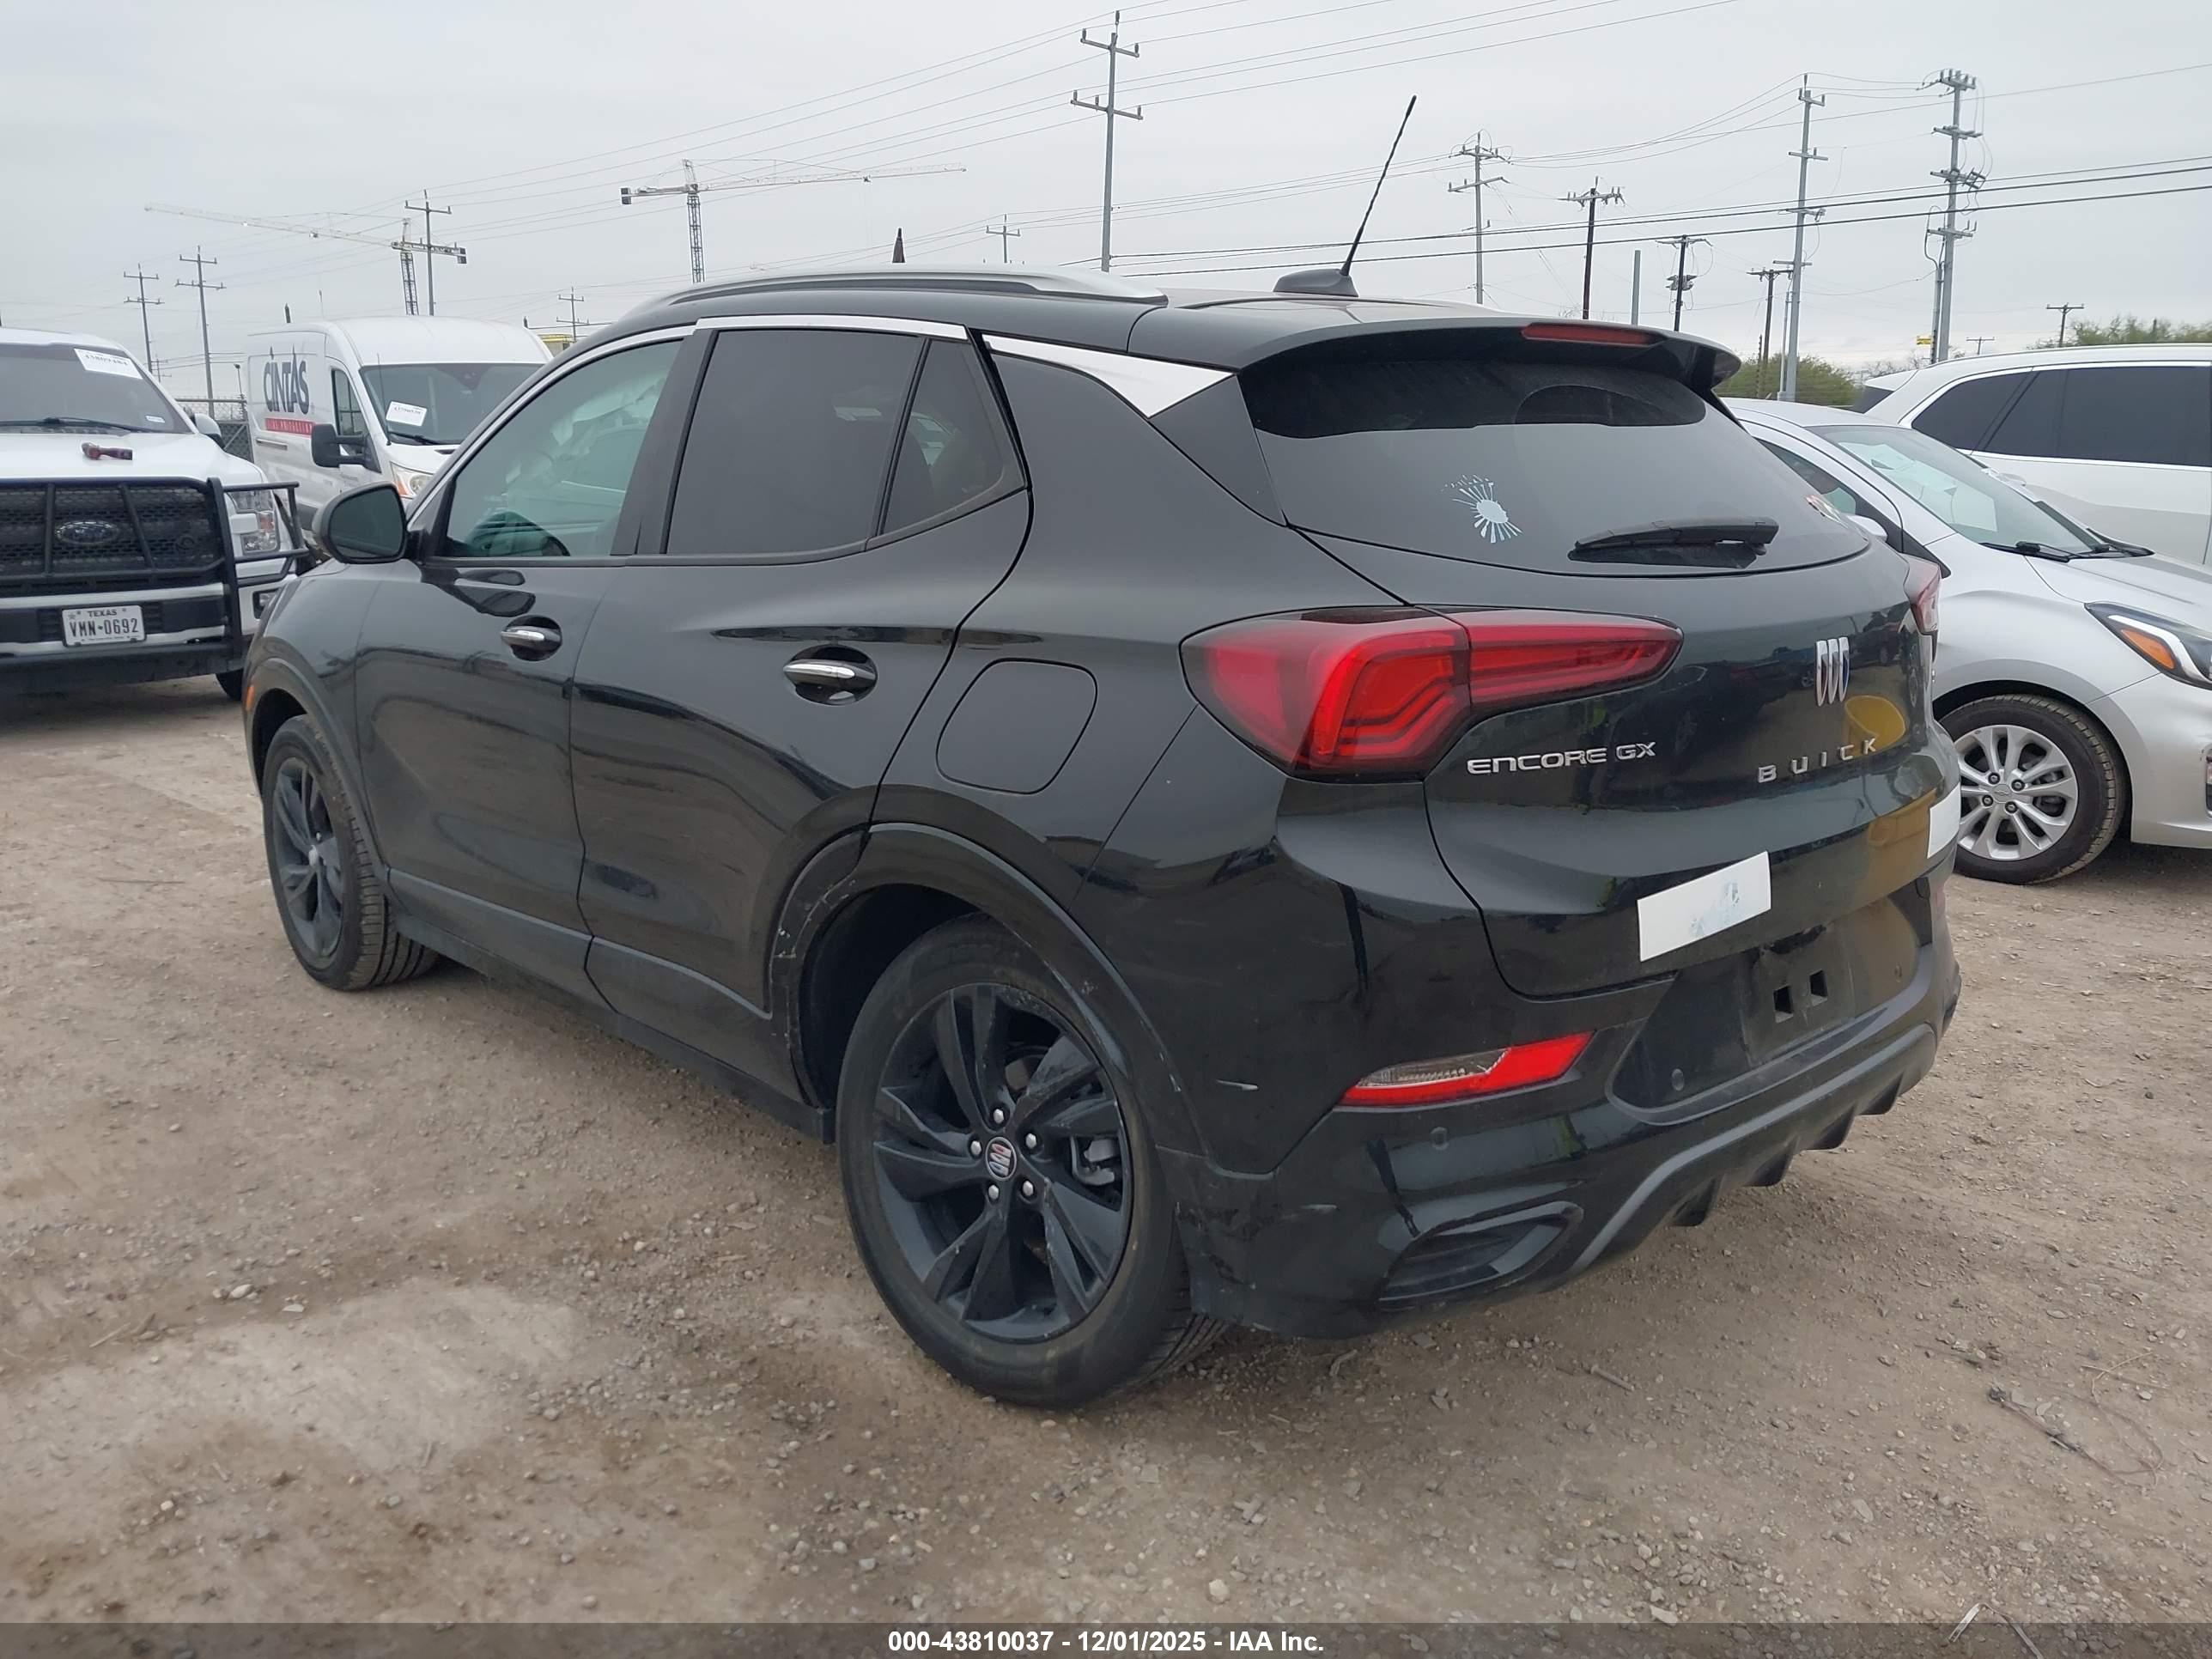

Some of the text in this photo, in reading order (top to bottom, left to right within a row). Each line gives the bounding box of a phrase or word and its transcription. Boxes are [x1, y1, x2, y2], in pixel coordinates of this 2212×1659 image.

[263, 344, 310, 415] CINTAS
[87, 609, 118, 618] TEXAS
[1467, 742, 1656, 775] ENCORE GX
[1758, 738, 1876, 783] BUICK
